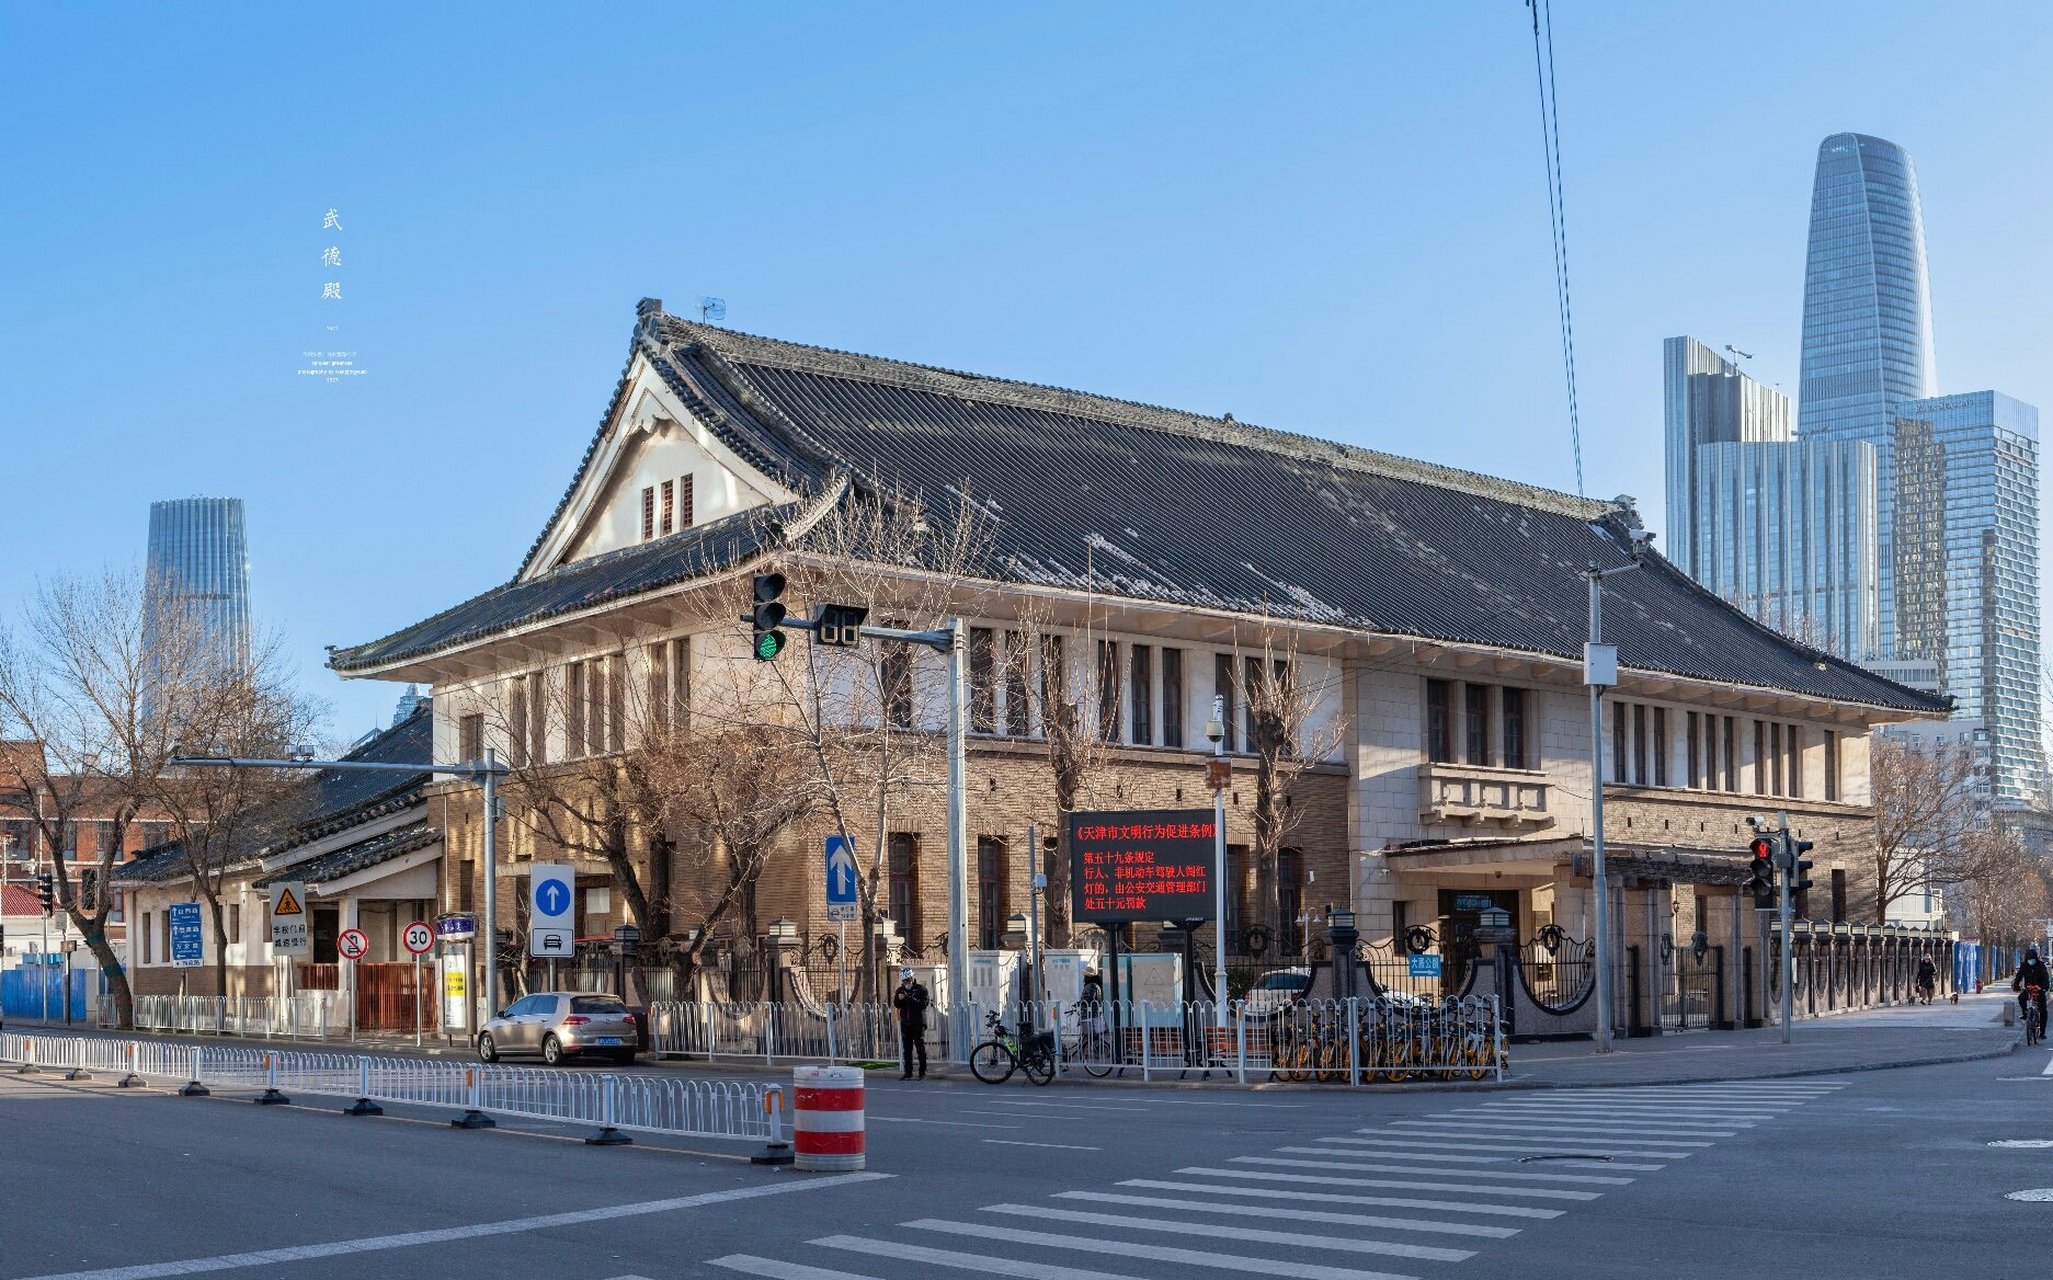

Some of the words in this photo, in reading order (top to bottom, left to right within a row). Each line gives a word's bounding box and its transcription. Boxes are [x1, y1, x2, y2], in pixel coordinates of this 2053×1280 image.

[1083, 851, 1155, 864] 第五十九条规定
[1084, 897, 1146, 911] 处五十元罚款
[410, 931, 428, 945] 30
